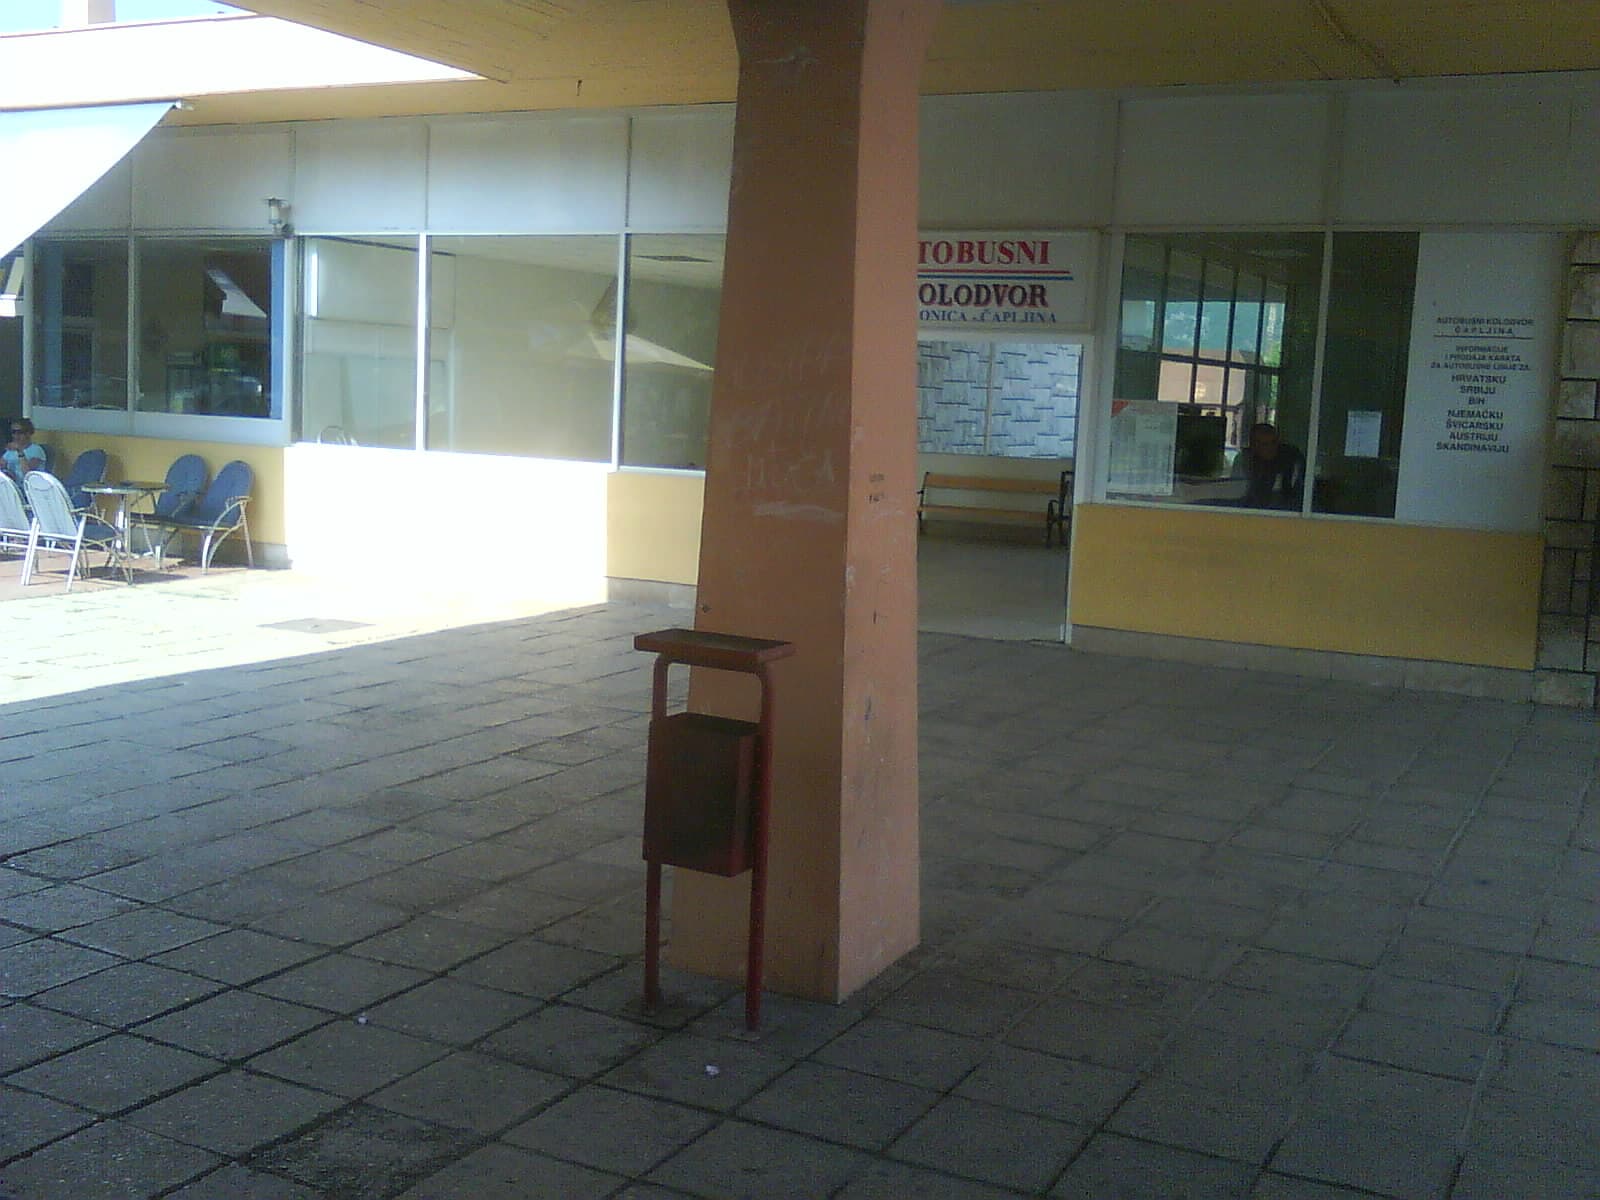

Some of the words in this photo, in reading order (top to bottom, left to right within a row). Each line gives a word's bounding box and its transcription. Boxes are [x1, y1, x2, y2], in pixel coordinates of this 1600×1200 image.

[918, 240, 1050, 265] TOBUSNI
[919, 283, 1048, 308] OLODVOR
[920, 310, 967, 322] ONICA
[1451, 374, 1507, 384] HRVATSKU
[1460, 385, 1496, 395] SRBIJU
[1449, 431, 1499, 441] AUSTRIJU
